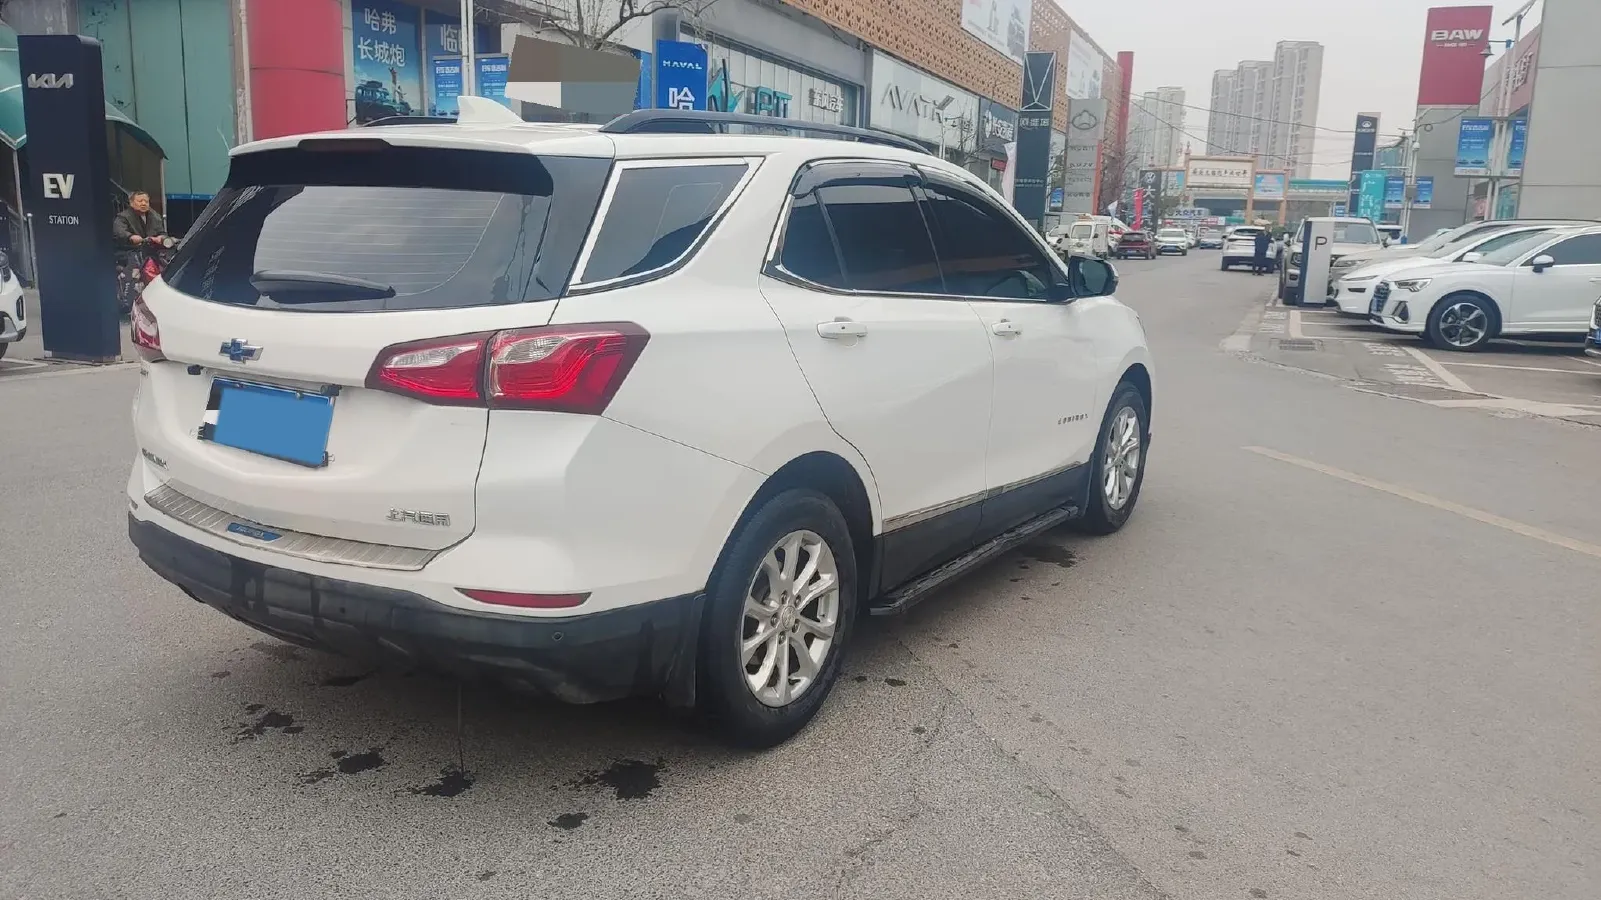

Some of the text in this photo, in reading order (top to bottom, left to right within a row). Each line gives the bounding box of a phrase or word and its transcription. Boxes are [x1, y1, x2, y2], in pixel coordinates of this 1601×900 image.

[364, 7, 397, 35] 哈弗
[1431, 29, 1484, 41] BAW
[357, 36, 406, 68] 长城炮
[662, 59, 703, 70] HAVAL
[27, 73, 75, 89] KIA
[42, 173, 75, 199] EV
[49, 215, 79, 225] STATION
[1315, 236, 1328, 251] P
